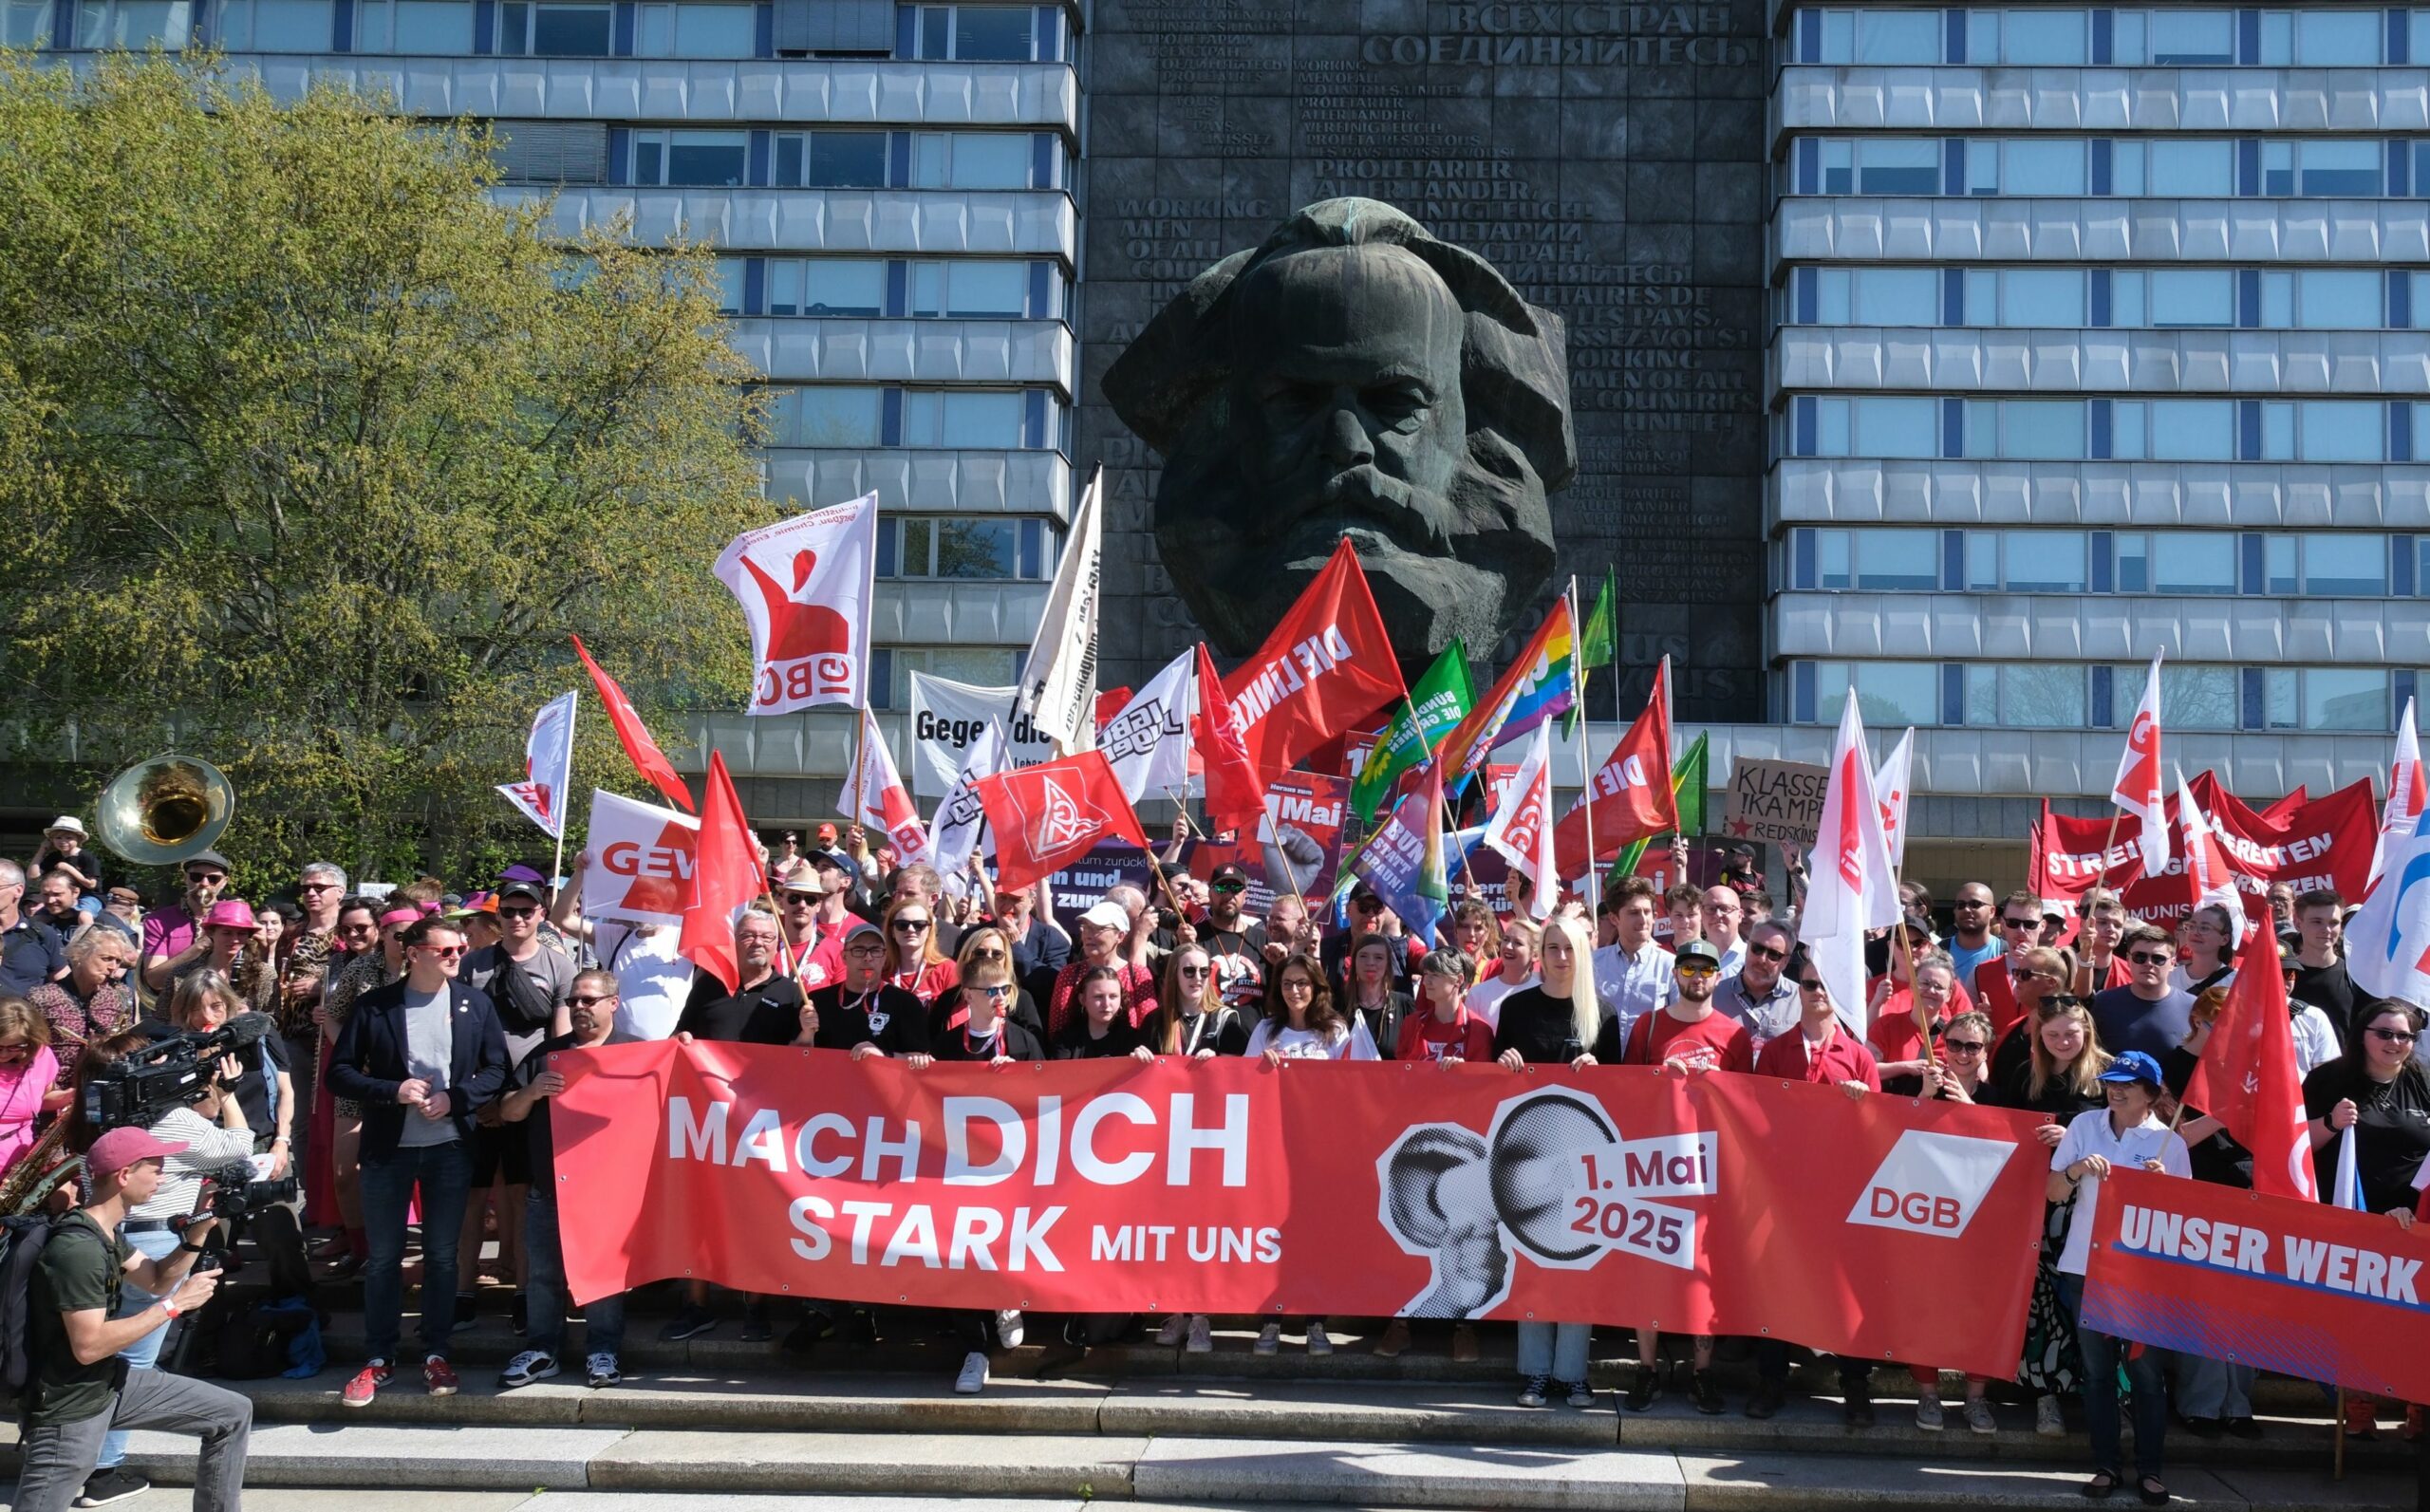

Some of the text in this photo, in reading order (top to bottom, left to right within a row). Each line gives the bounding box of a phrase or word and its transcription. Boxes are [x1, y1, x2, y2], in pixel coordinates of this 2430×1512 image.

[1448, 5, 1561, 33] ВСЕХ
[1293, 60, 1368, 72] WORKING
[1298, 72, 1330, 84] MEN
[1298, 97, 1404, 108] PROLETARIER
[1301, 109, 1346, 121] ALLER
[1315, 159, 1512, 178] PROLETARIER
[1314, 180, 1403, 199] ALLER
[1115, 198, 1271, 217] WORKING
[1502, 201, 1595, 220] EUCH!
[1119, 219, 1191, 237] MEN
[1126, 239, 1220, 258] OF ALL
[1669, 287, 1710, 306] DE
[1578, 307, 1624, 327] LES
[1570, 371, 1748, 390] MEN OF ALL
[917, 710, 985, 749] Gege
[1281, 796, 1342, 828] Mai
[1383, 816, 1425, 865] BUN
[1105, 857, 1146, 868] zurück!
[1372, 837, 1412, 874] STATT
[1075, 869, 1121, 887] und
[1360, 849, 1406, 893] BRAUN!
[668, 1093, 1248, 1187] MACH DICH
[1580, 1144, 1709, 1191] 1. Mai
[1870, 1187, 1961, 1229] DGB
[789, 1196, 1282, 1273] STARK MIT UNS
[1570, 1196, 1684, 1256] 2025
[2121, 1204, 2424, 1305] UNSER WERK
